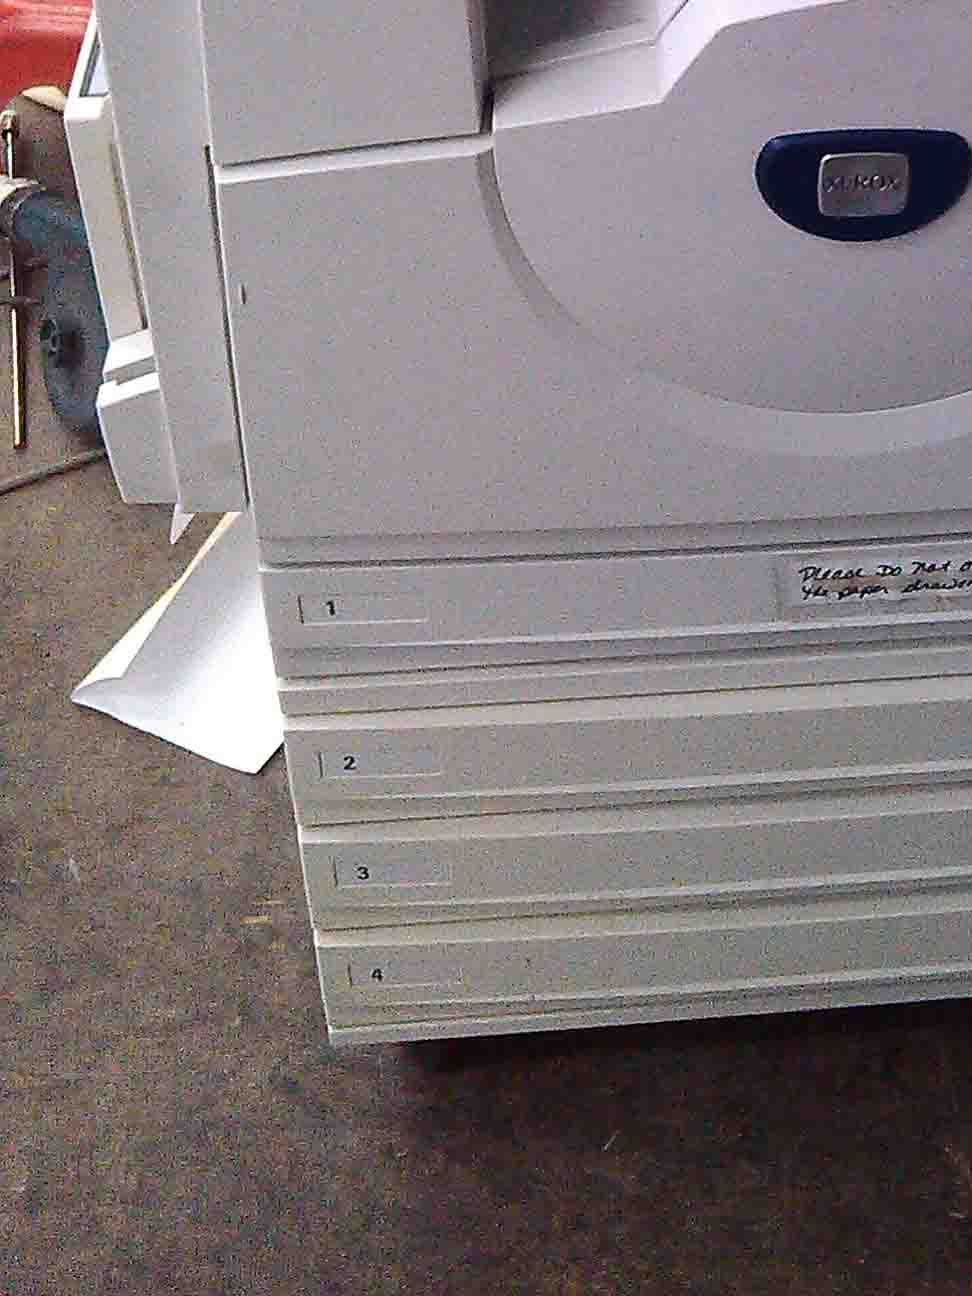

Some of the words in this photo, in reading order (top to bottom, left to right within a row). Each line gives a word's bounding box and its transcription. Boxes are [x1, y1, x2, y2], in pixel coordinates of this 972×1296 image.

[326, 600, 337, 616] 1
[343, 756, 357, 771] 2
[356, 866, 370, 881] 3
[371, 968, 384, 982] 4
